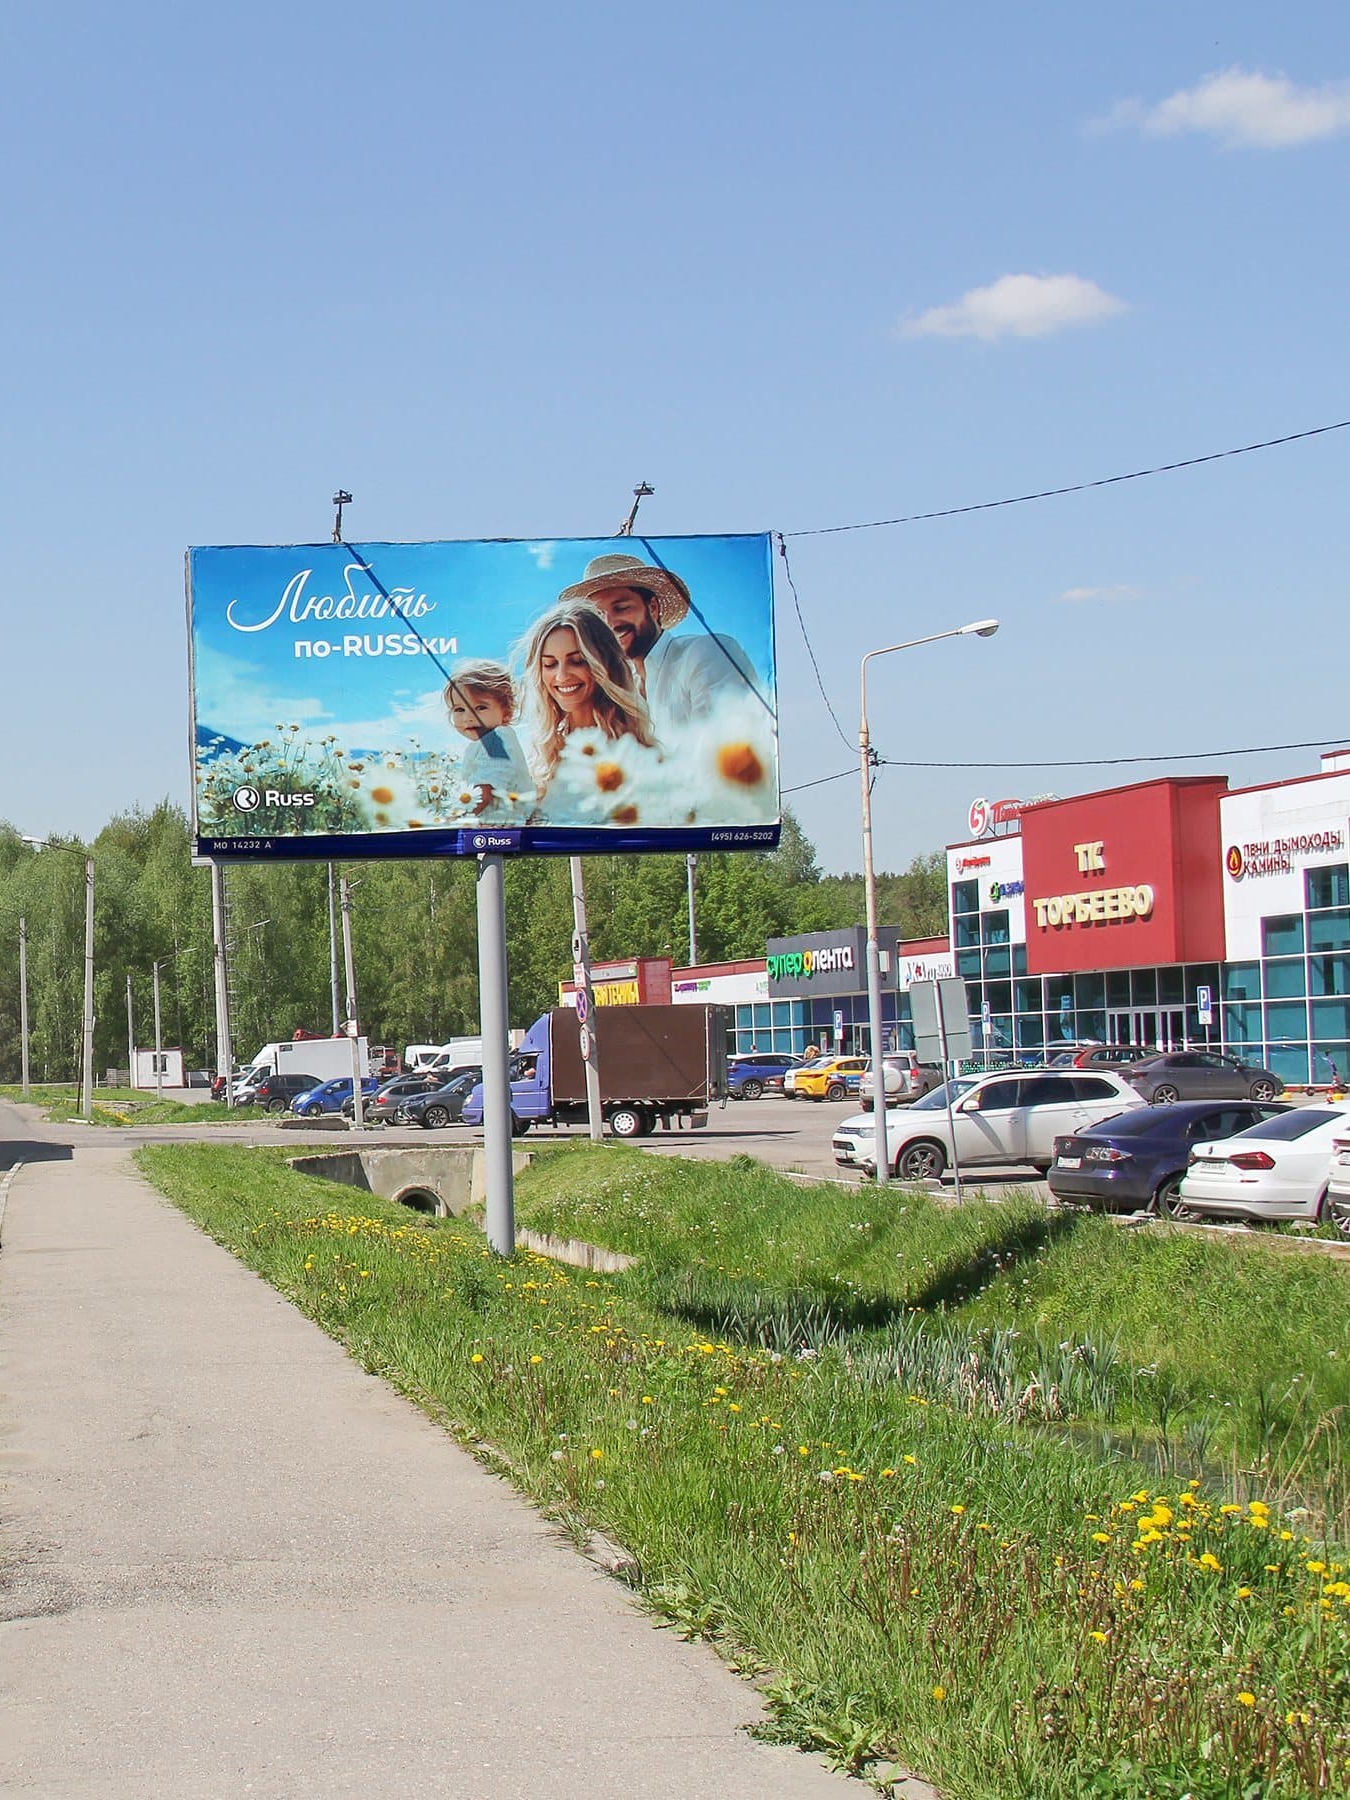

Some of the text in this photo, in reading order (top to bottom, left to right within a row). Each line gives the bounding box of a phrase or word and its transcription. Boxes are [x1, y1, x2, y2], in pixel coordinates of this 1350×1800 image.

[227, 563, 437, 632] Любить
[294, 634, 458, 657] по-RUSSки
[266, 790, 315, 807] Russ
[232, 840, 261, 849] 14232
[488, 836, 512, 846] Russ
[733, 832, 774, 840] 626-5202
[1243, 829, 1341, 857] ПЕЧИ ДЫМОХОДЫ
[1074, 840, 1106, 872] ТК
[1243, 854, 1291, 874] КАМИНЫ
[1032, 884, 1154, 928] ТОРБЕЕВО
